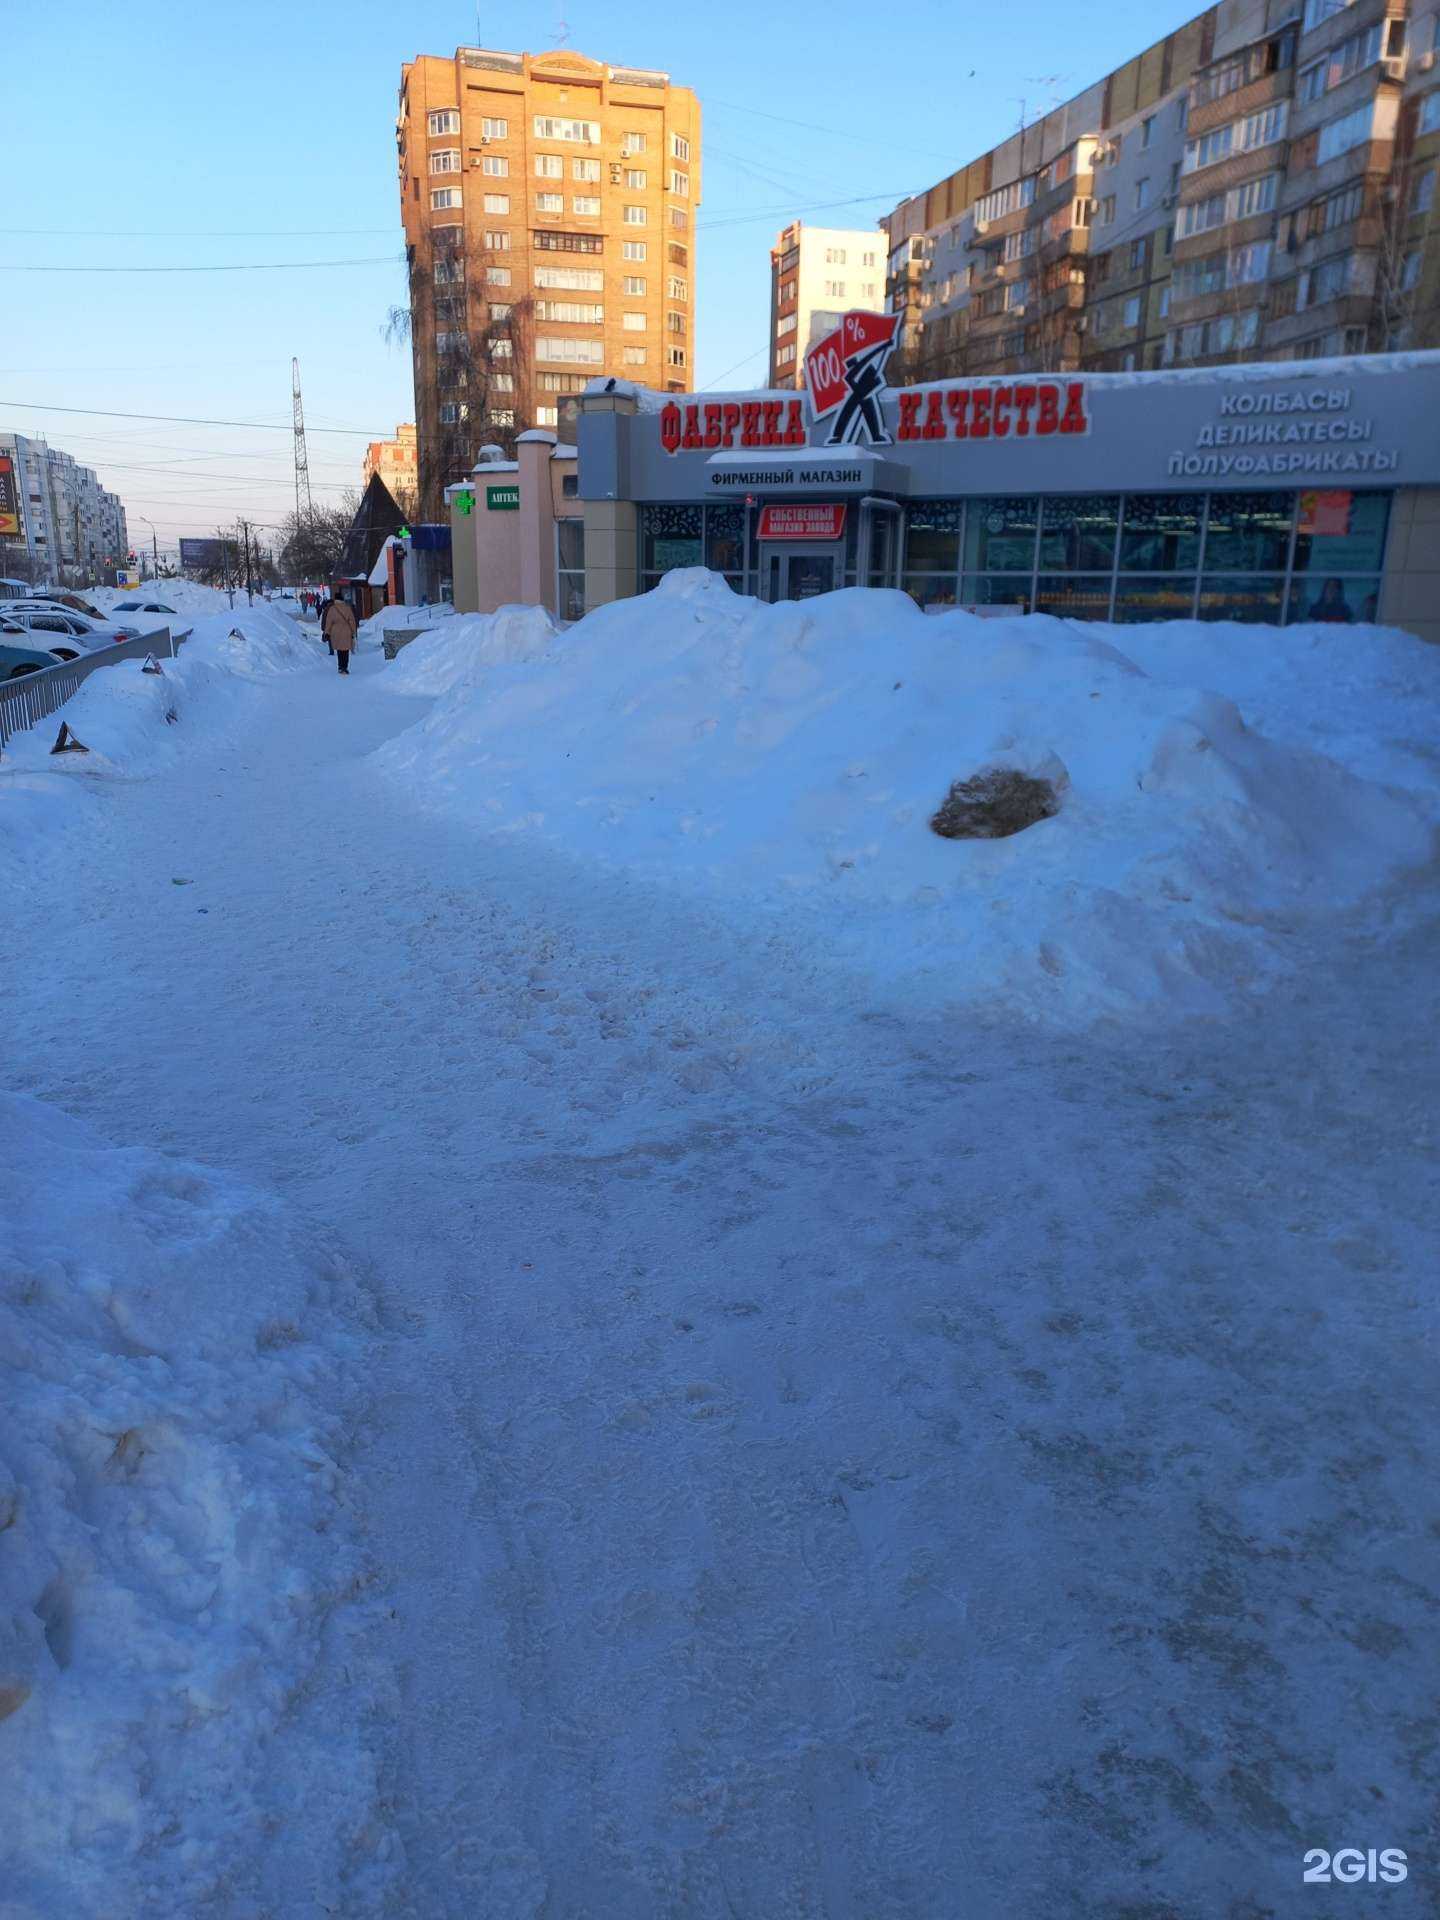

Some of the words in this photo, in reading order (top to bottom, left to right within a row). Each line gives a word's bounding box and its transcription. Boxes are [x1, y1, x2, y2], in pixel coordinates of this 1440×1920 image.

[809, 347, 841, 392] 100
[1220, 389, 1352, 416] КОЛБАСЫ
[660, 400, 806, 454] ФАБРИКА
[897, 382, 1087, 442] КАЧЕСТВА
[1196, 420, 1372, 448] ДЕЛИКАТЕСЫ
[1167, 450, 1398, 476] ПОЛУФАБРИКАТЫ
[711, 469, 794, 486] ФИРМЕННЫЙ
[799, 470, 861, 483] МАГАЗИН
[491, 492, 519, 503] АПТЕК
